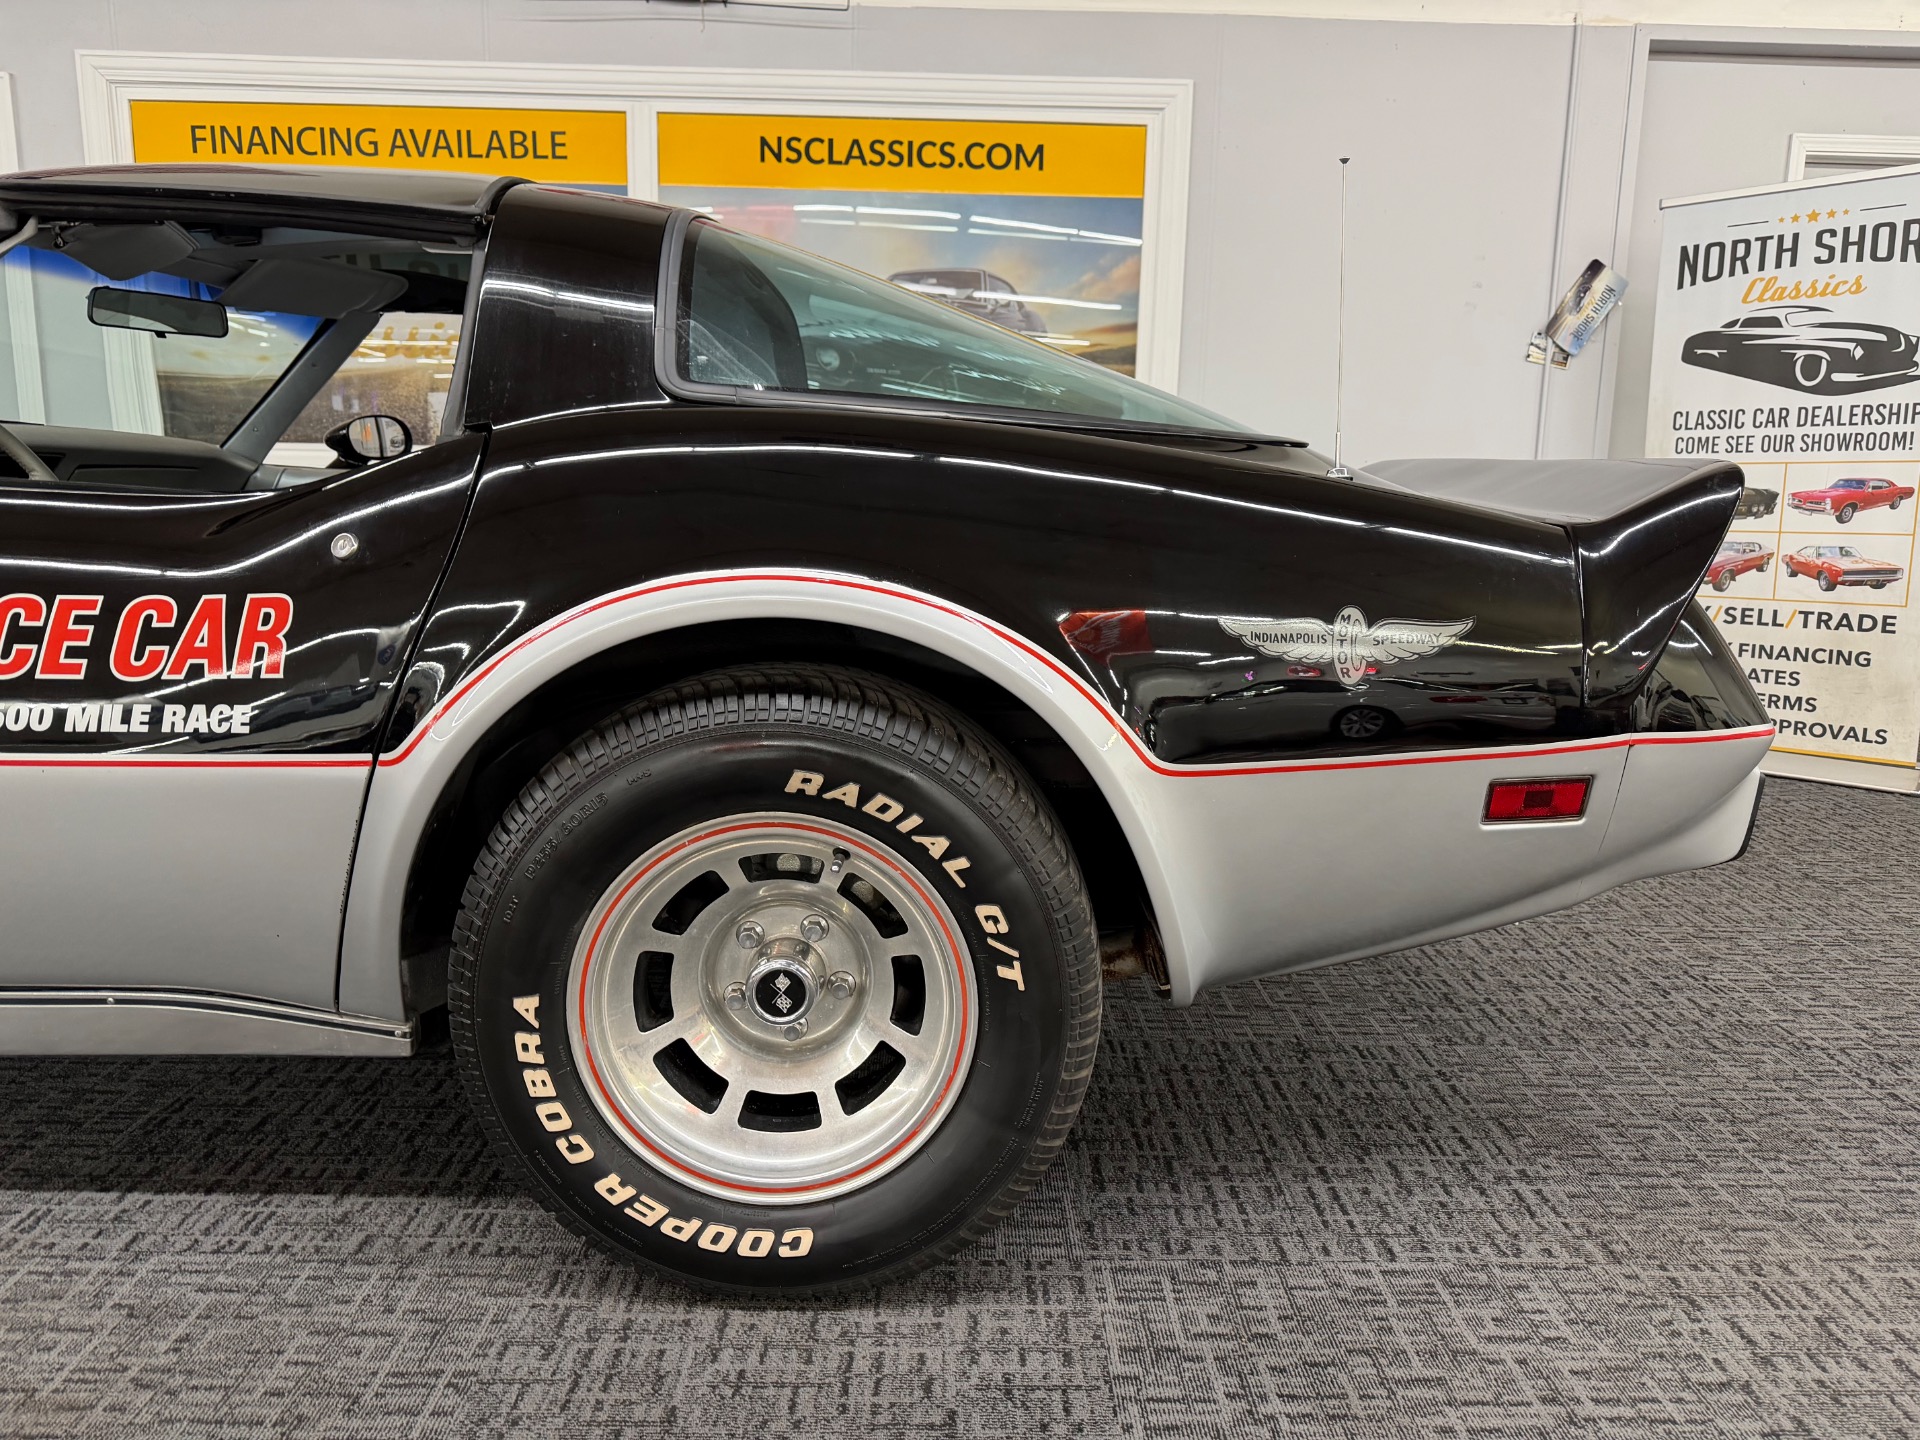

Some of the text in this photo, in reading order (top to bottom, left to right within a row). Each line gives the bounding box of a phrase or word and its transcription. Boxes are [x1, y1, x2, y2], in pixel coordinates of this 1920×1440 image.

[190, 124, 568, 160] FINANCING AVAILABLE
[759, 136, 1045, 171] NSCLASSICS.COM
[1677, 232, 1800, 290] NORTH
[1591, 284, 1616, 315] NORTH
[1741, 273, 1867, 304] Classics
[1569, 313, 1595, 341] SHORE
[1672, 402, 1920, 431] CLASSIC CAR DEALERSHIP
[1675, 431, 1915, 455] COME SEE OUR SHOWROOM!
[109, 593, 294, 682] CAR
[1250, 614, 1442, 679] INDIANAPOLIS MOTOR SPEEDWAY
[1738, 642, 1872, 668] FINANCING
[0, 703, 253, 734] 00 MILE RACE
[784, 769, 974, 889] RADIAL
[974, 904, 1026, 993] G/T
[512, 993, 593, 1165] COBRA
[593, 1170, 815, 1259] COOPER
